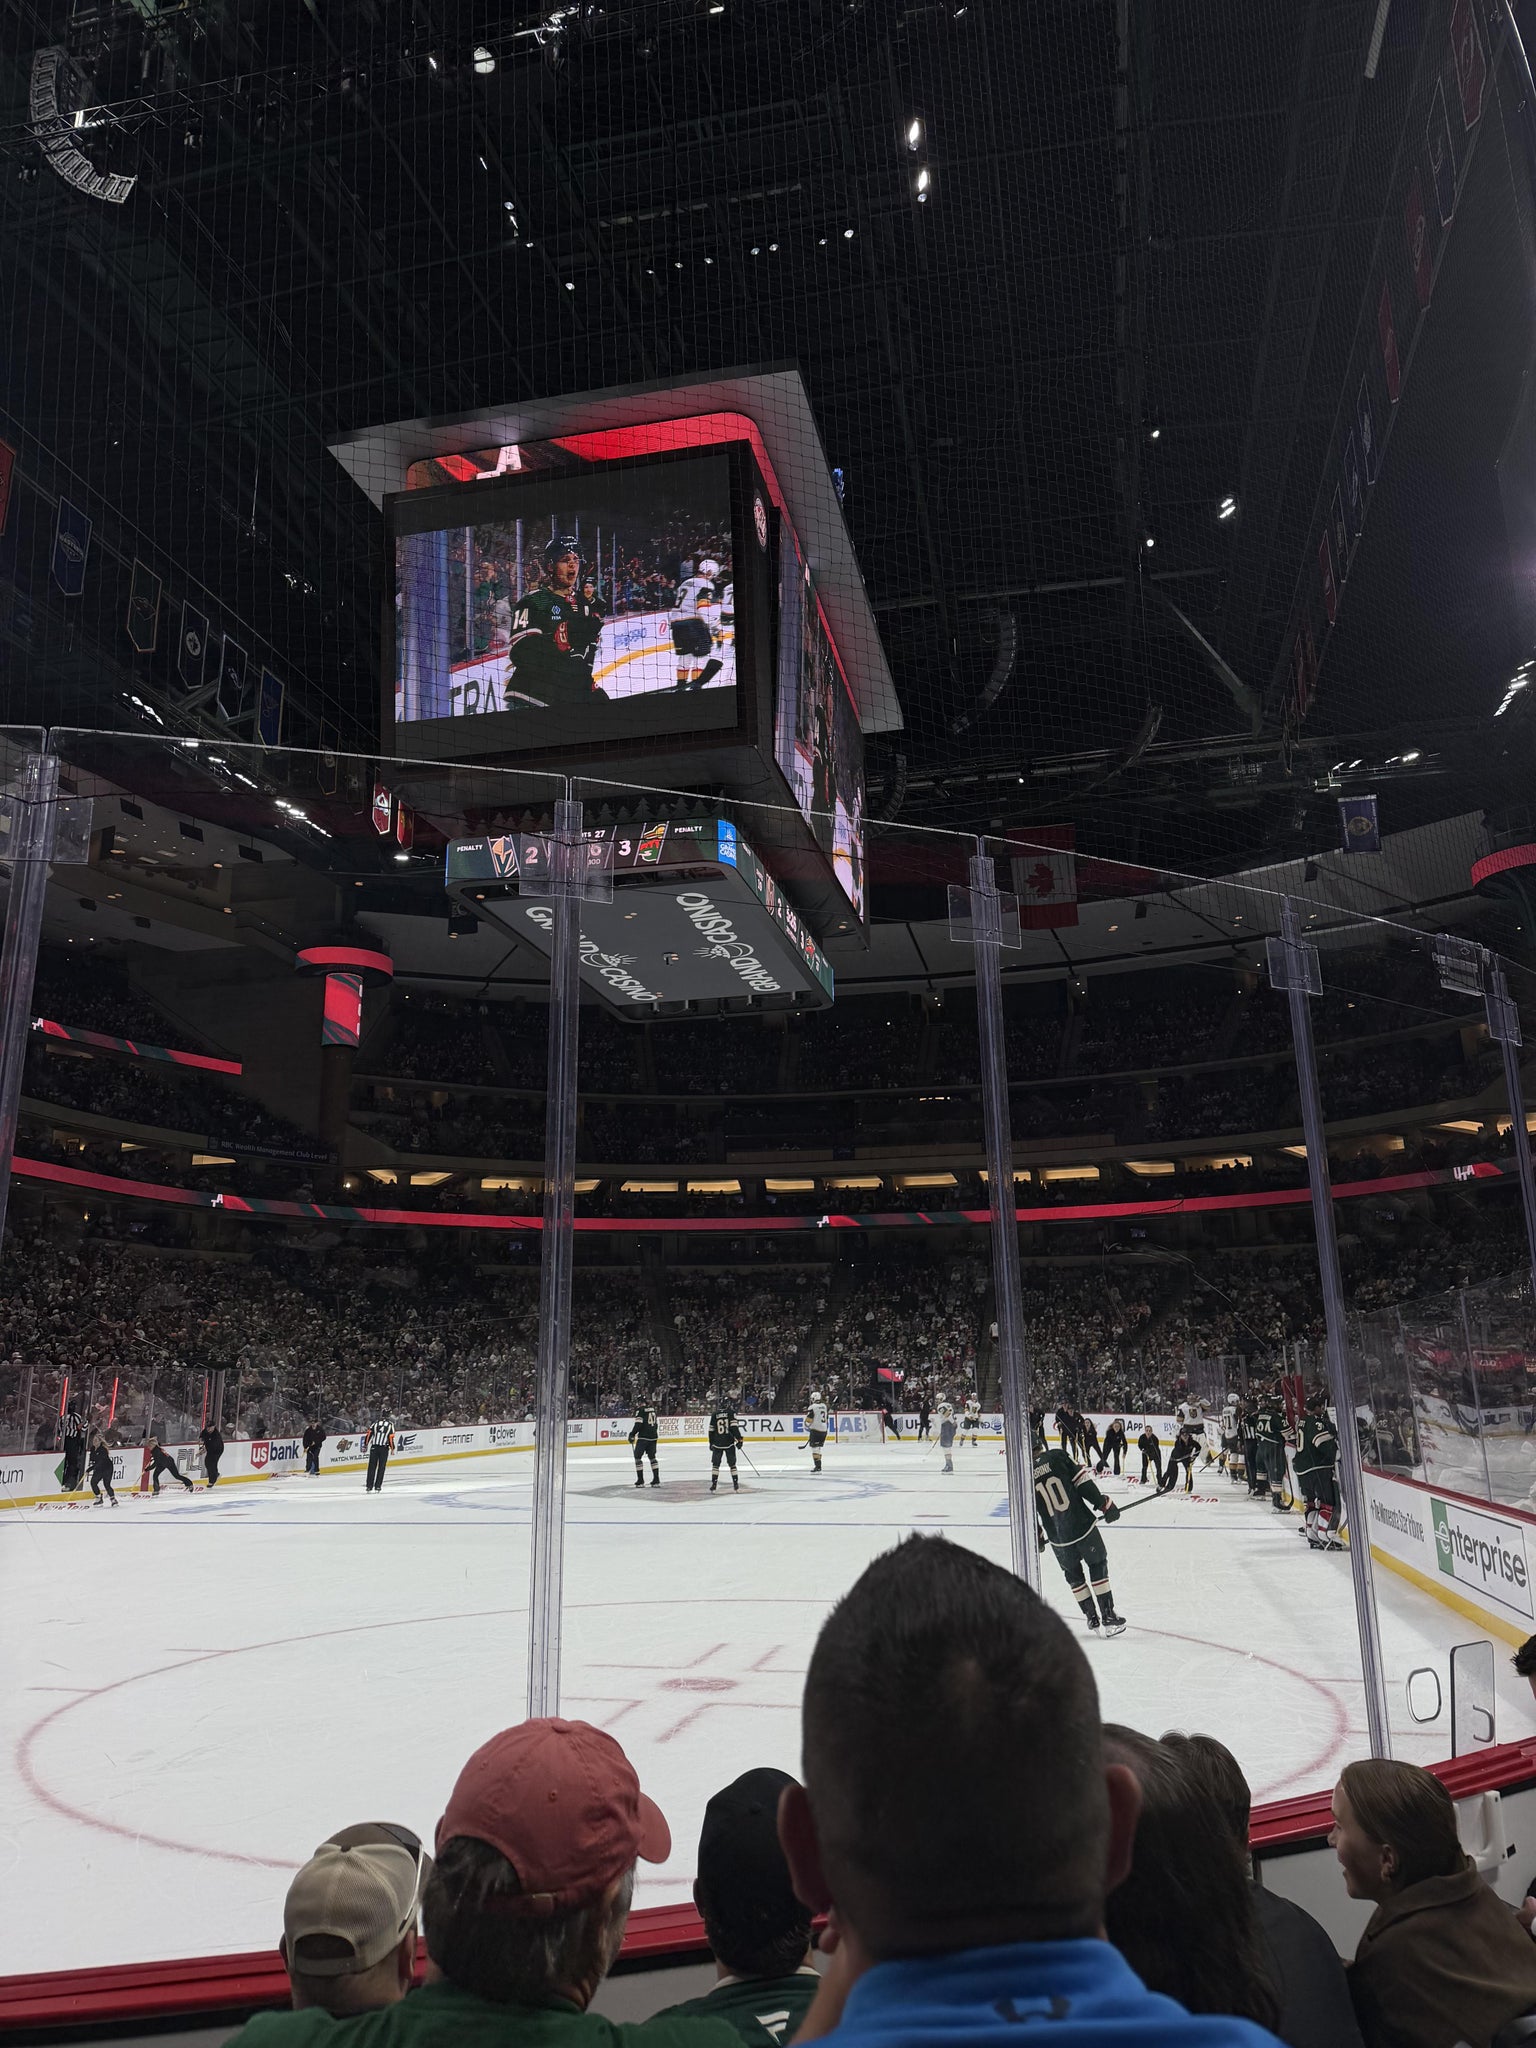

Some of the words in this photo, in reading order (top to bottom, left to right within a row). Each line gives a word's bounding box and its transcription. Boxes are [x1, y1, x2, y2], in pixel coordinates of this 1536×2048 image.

[513, 608, 529, 630] 14
[595, 830, 606, 838] 27
[457, 845, 483, 853] PENALTY
[525, 847, 539, 865] 2
[618, 840, 632, 856] 3
[676, 892, 738, 943] CASINO
[730, 957, 781, 992] GRAND
[600, 967, 658, 1001] CASINO
[497, 1426, 516, 1440] clover
[738, 1419, 784, 1432] RTRA
[793, 1417, 868, 1433] ELAB
[1127, 1421, 1143, 1431] App
[443, 1434, 474, 1445] FORTINET
[253, 1448, 268, 1463] us
[270, 1444, 299, 1461] bank
[1035, 1476, 1070, 1517] 10
[1435, 1520, 1526, 1588] enterprise
